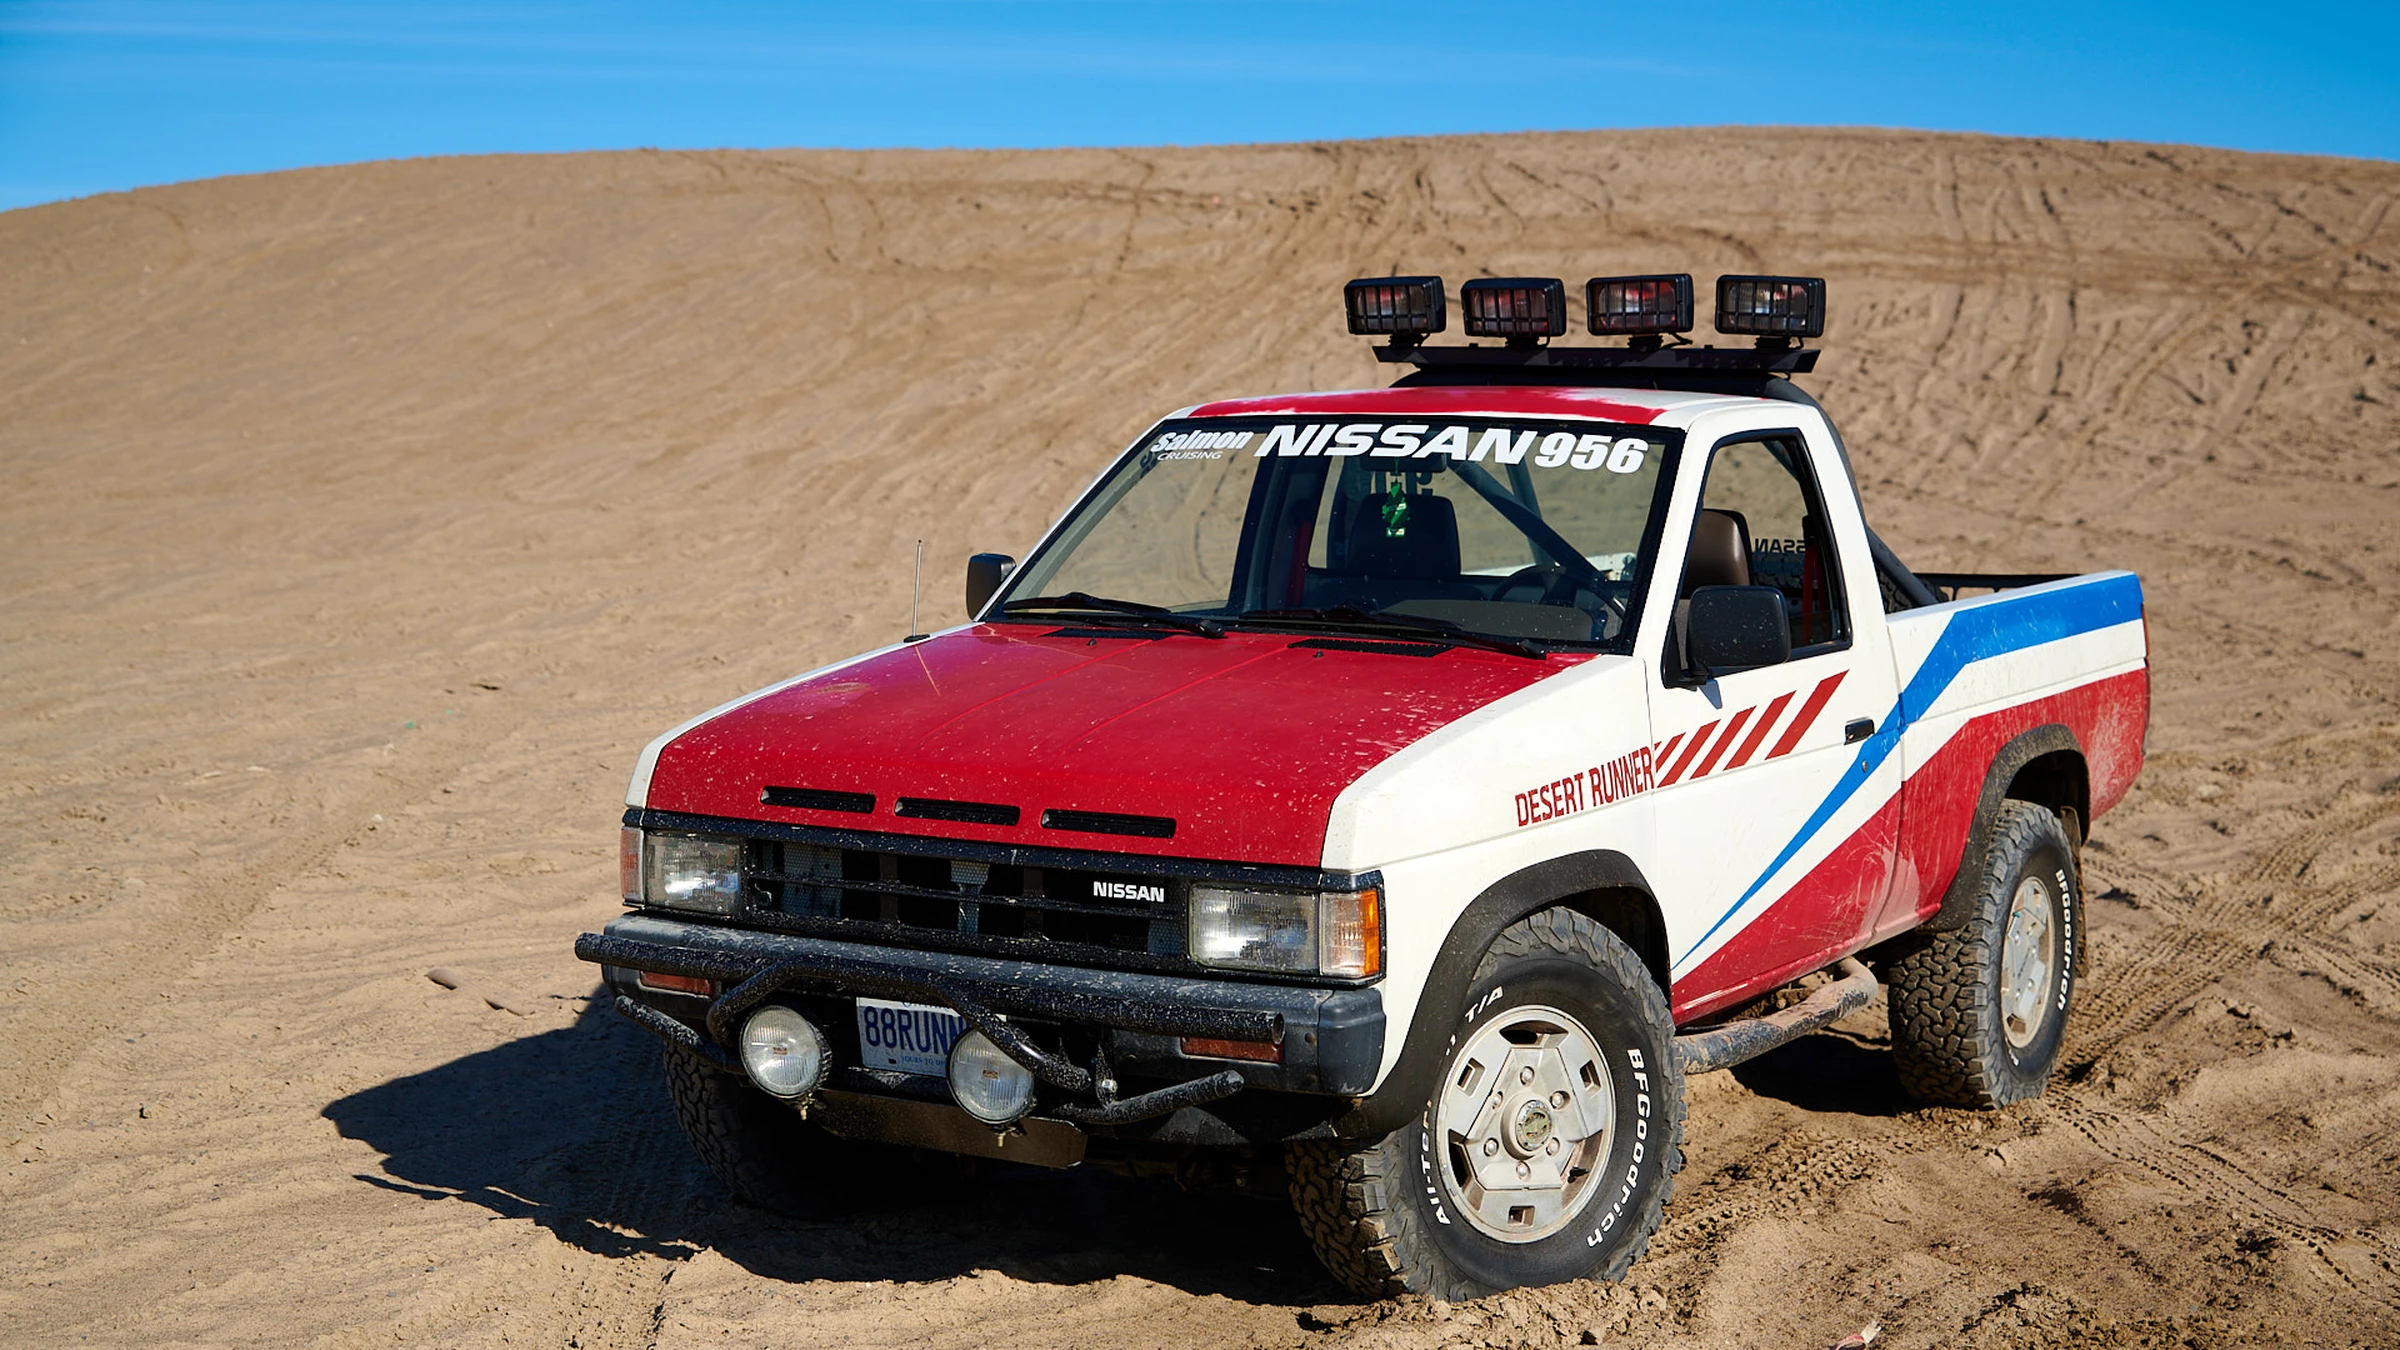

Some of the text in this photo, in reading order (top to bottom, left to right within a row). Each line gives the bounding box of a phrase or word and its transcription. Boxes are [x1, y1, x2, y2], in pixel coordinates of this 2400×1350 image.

[1150, 429, 1255, 452] Salmon
[1157, 451, 1224, 461] CRUISING
[1253, 424, 1650, 474] NISSAN 956
[1514, 746, 1655, 828] DESERT RUNNER
[1093, 881, 1165, 903] NISSAN
[1464, 986, 1504, 1023] T/A
[863, 1005, 969, 1056] 88RUNN
[1586, 1048, 1651, 1248] BFGoodrich
